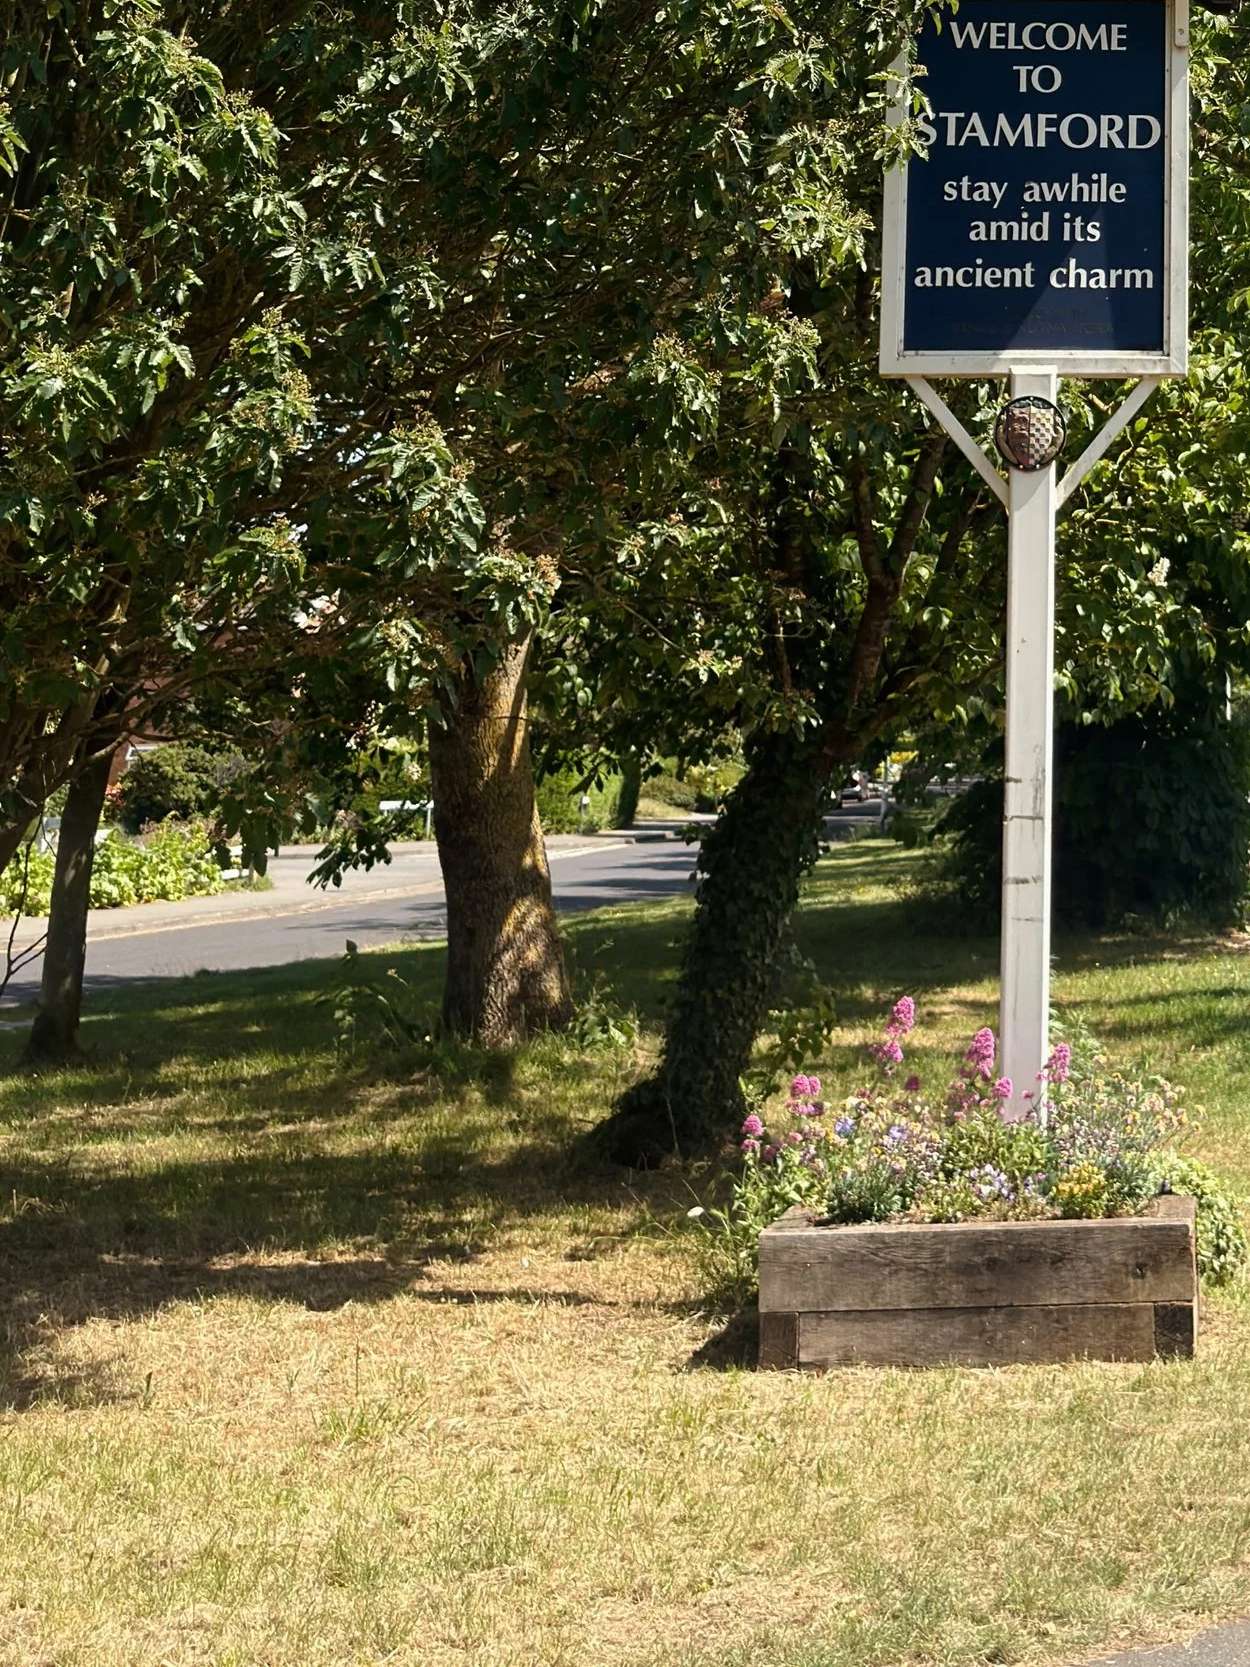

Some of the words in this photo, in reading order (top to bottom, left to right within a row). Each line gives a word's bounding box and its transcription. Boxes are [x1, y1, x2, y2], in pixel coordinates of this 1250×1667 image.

[949, 21, 1127, 51] WELCOME
[1012, 64, 1062, 93] TO
[916, 111, 1161, 150] STAMFORD
[943, 175, 1008, 209] stay
[1023, 172, 1127, 203] awhile
[969, 211, 1049, 242] amid
[1063, 212, 1101, 242] its
[914, 258, 1035, 288] ancient
[1049, 258, 1154, 289] charm
